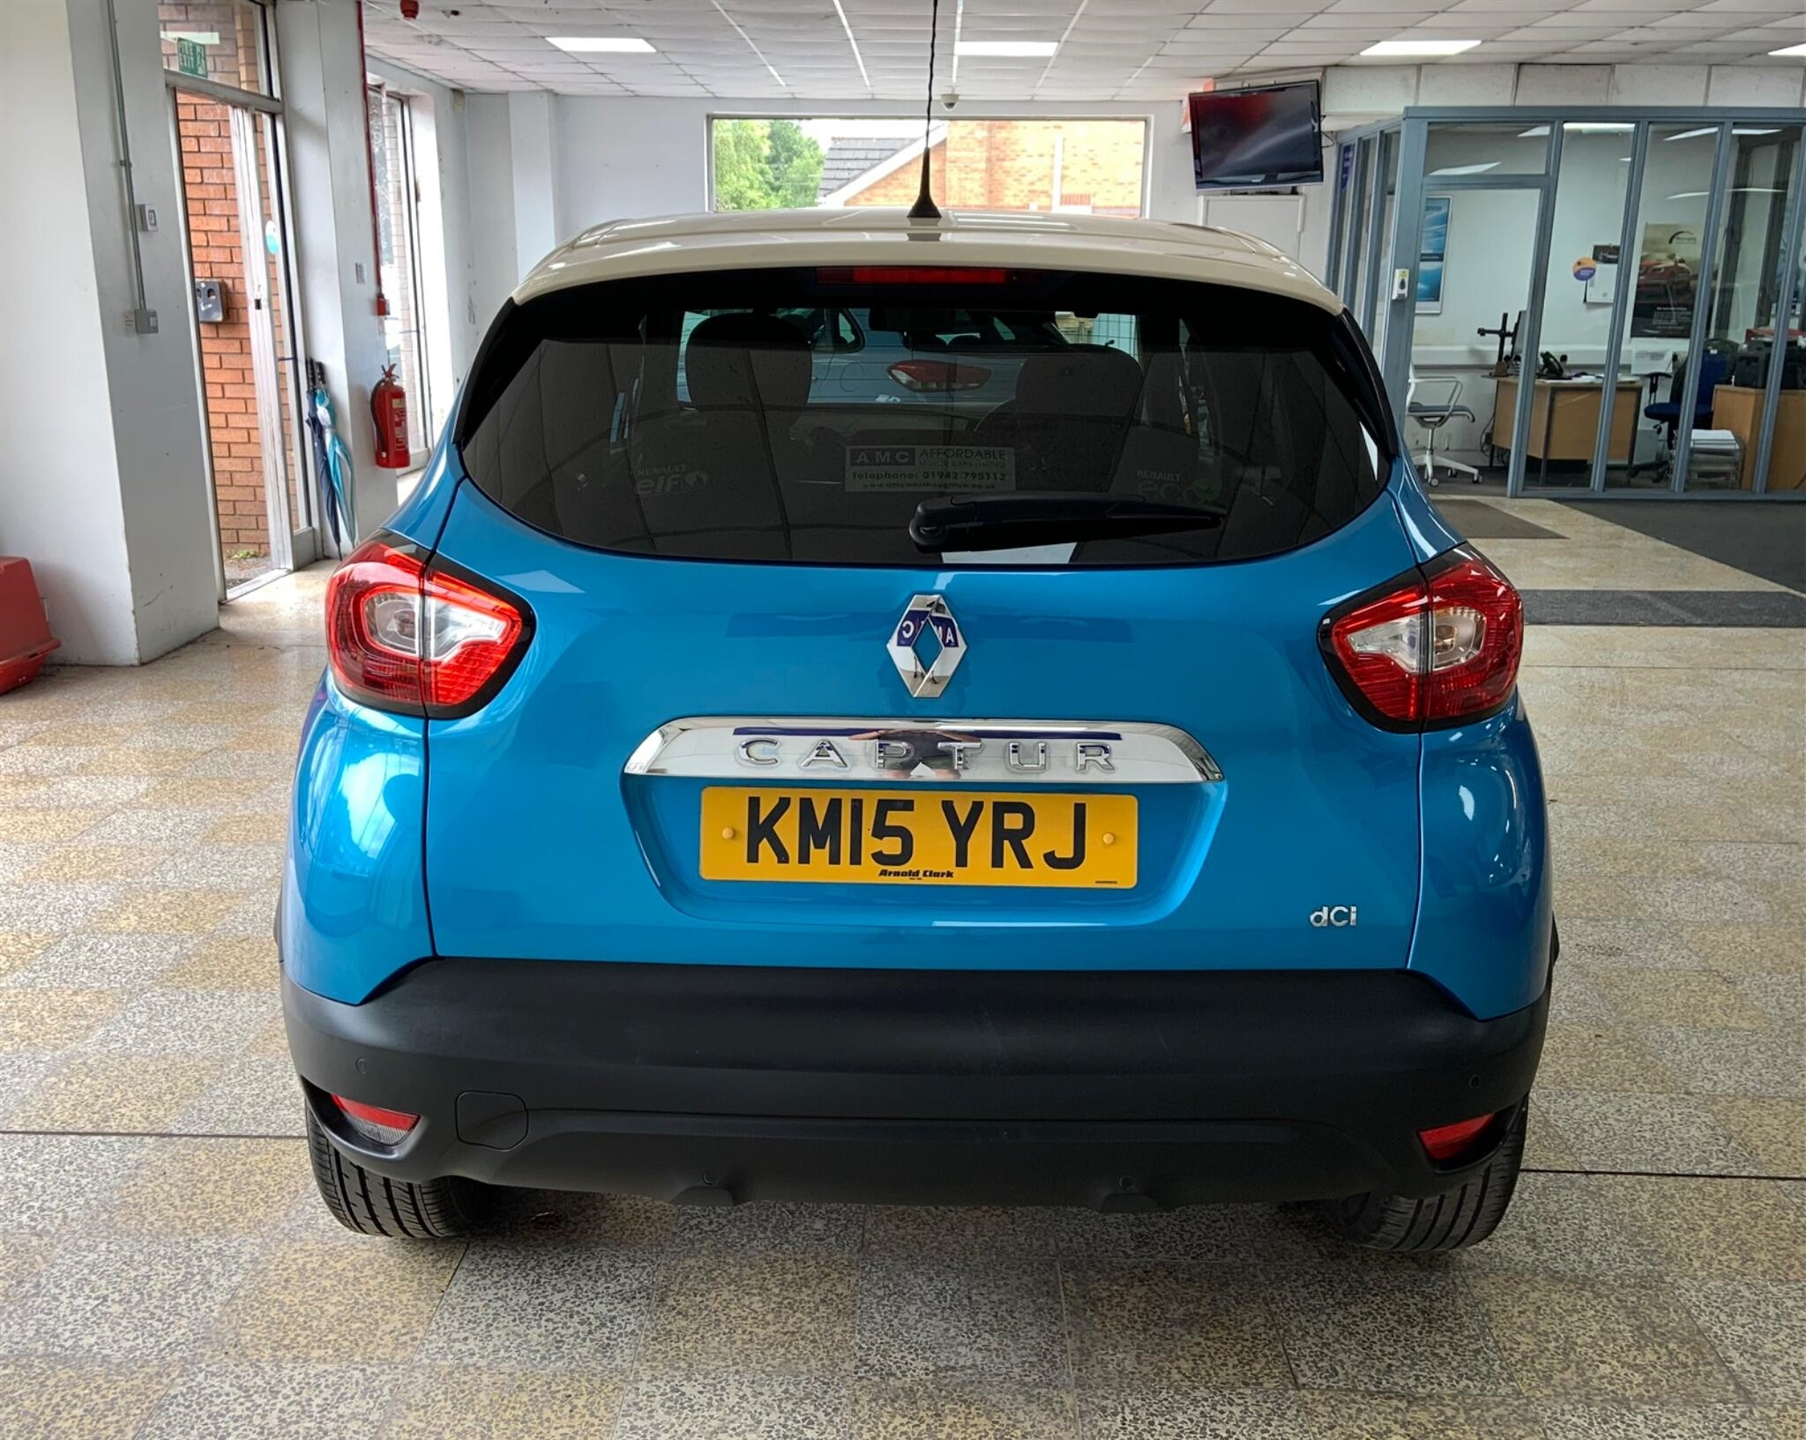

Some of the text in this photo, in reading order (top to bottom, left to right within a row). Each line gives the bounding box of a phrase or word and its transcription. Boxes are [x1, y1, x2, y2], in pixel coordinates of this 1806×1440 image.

[856, 451, 911, 464] AMC
[919, 448, 1006, 460] AFFORDABLE
[636, 463, 687, 476] RENAULT
[852, 471, 1007, 481] Telephone: 01942 795112
[1136, 468, 1181, 482] RENAULT
[636, 474, 681, 495] elf
[740, 738, 1117, 773] CAPTUR
[746, 796, 1087, 870] KM15 YRJ
[878, 869, 954, 878] Arnold Clark
[1309, 905, 1357, 928] dCi
